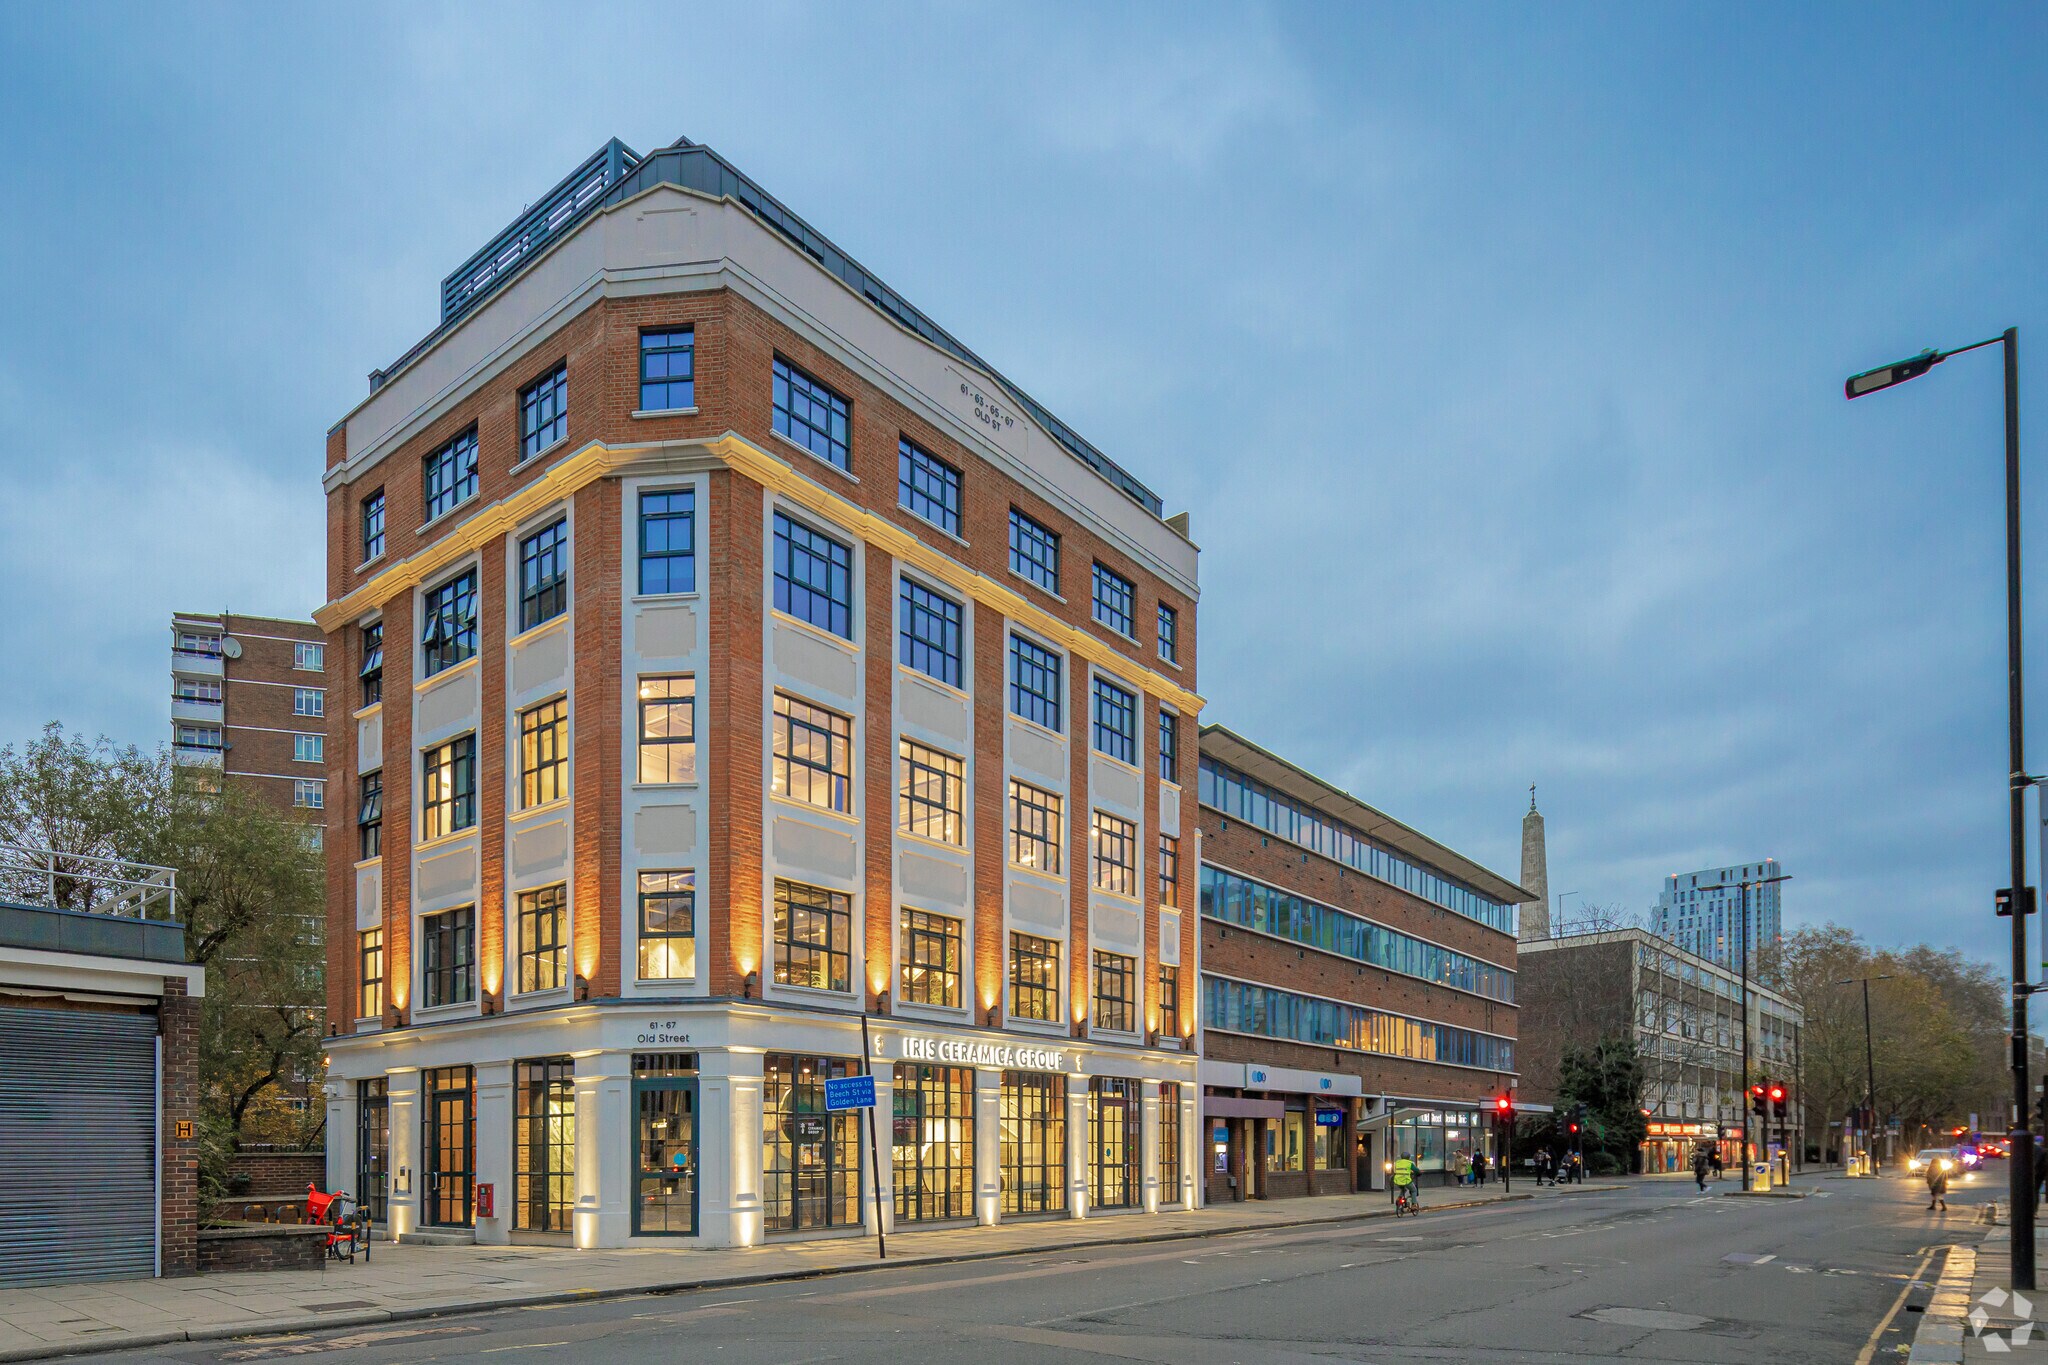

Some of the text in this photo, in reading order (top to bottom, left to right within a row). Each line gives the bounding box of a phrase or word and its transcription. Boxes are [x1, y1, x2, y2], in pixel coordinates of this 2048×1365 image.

[961, 383, 968, 395] 61
[975, 394, 984, 406] 63
[990, 405, 999, 418] 65
[1005, 416, 1014, 428] 67
[974, 407, 1001, 431] OLD ST
[666, 1021, 676, 1029] 67
[637, 1034, 690, 1043] Old Street
[902, 1037, 1064, 1070] IRIS CERAMICA GROUP
[840, 1081, 862, 1089] access
[829, 1090, 850, 1098] Beech
[830, 1096, 872, 1106] Golden Lane
[178, 1122, 190, 1136] H
